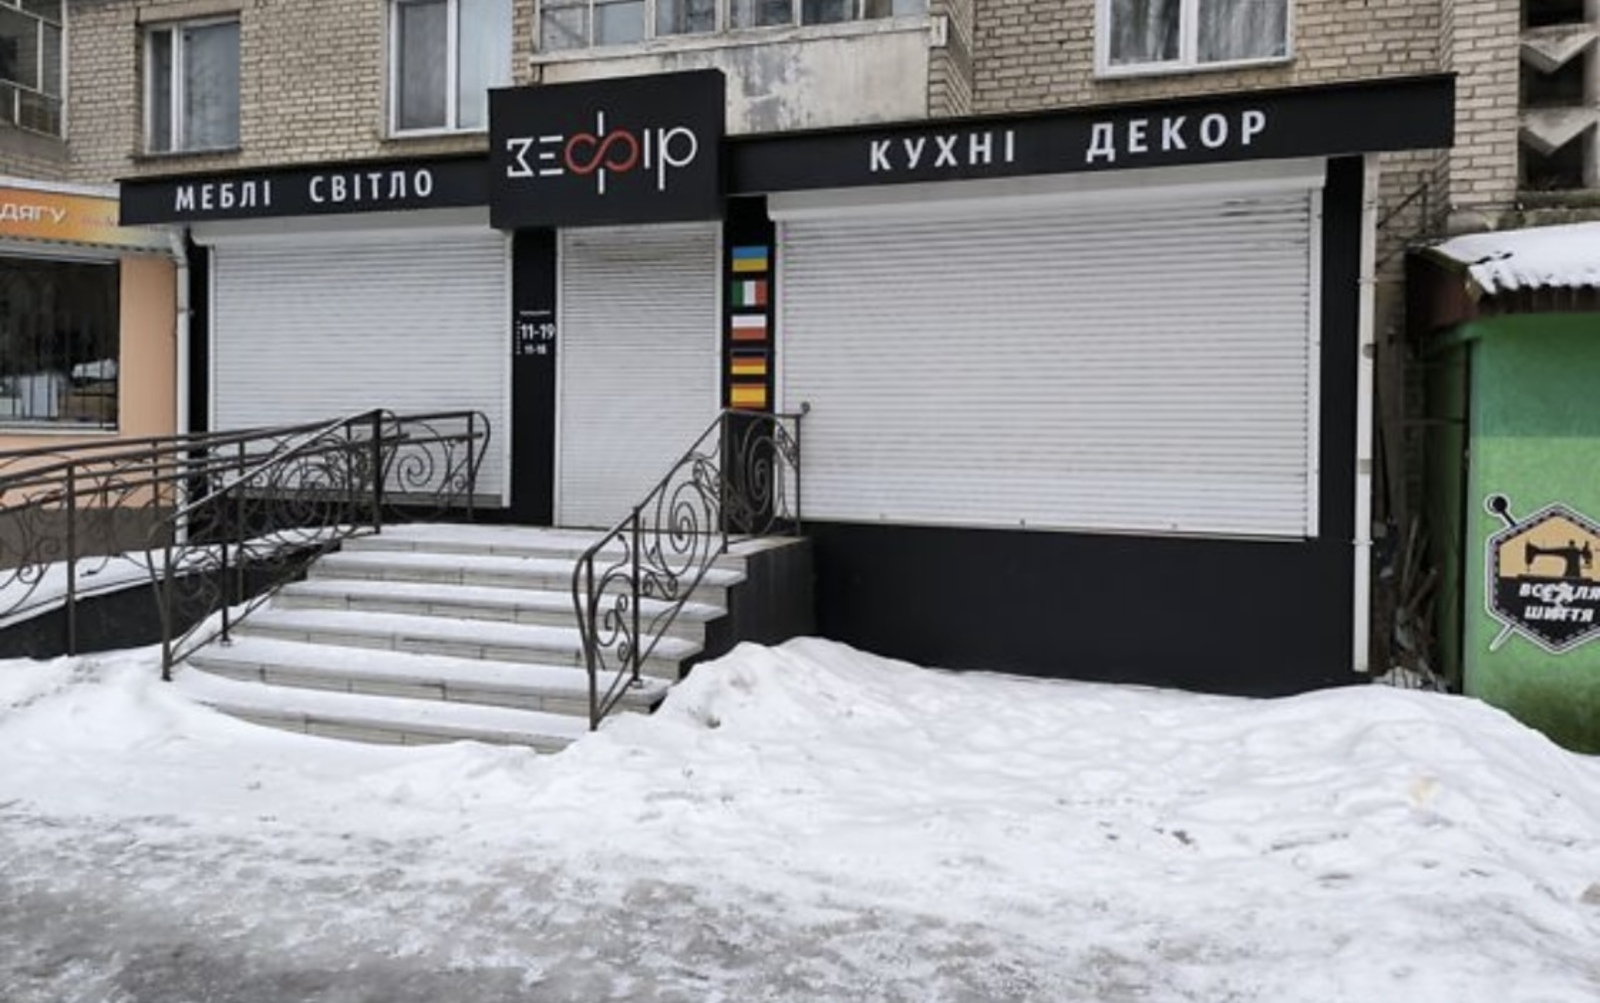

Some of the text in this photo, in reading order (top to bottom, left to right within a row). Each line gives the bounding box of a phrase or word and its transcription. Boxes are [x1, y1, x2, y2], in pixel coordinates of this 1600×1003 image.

[869, 110, 1267, 172] КУХНІ ДЕКОР
[175, 169, 433, 211] МЕБЛІ СВІТЛО
